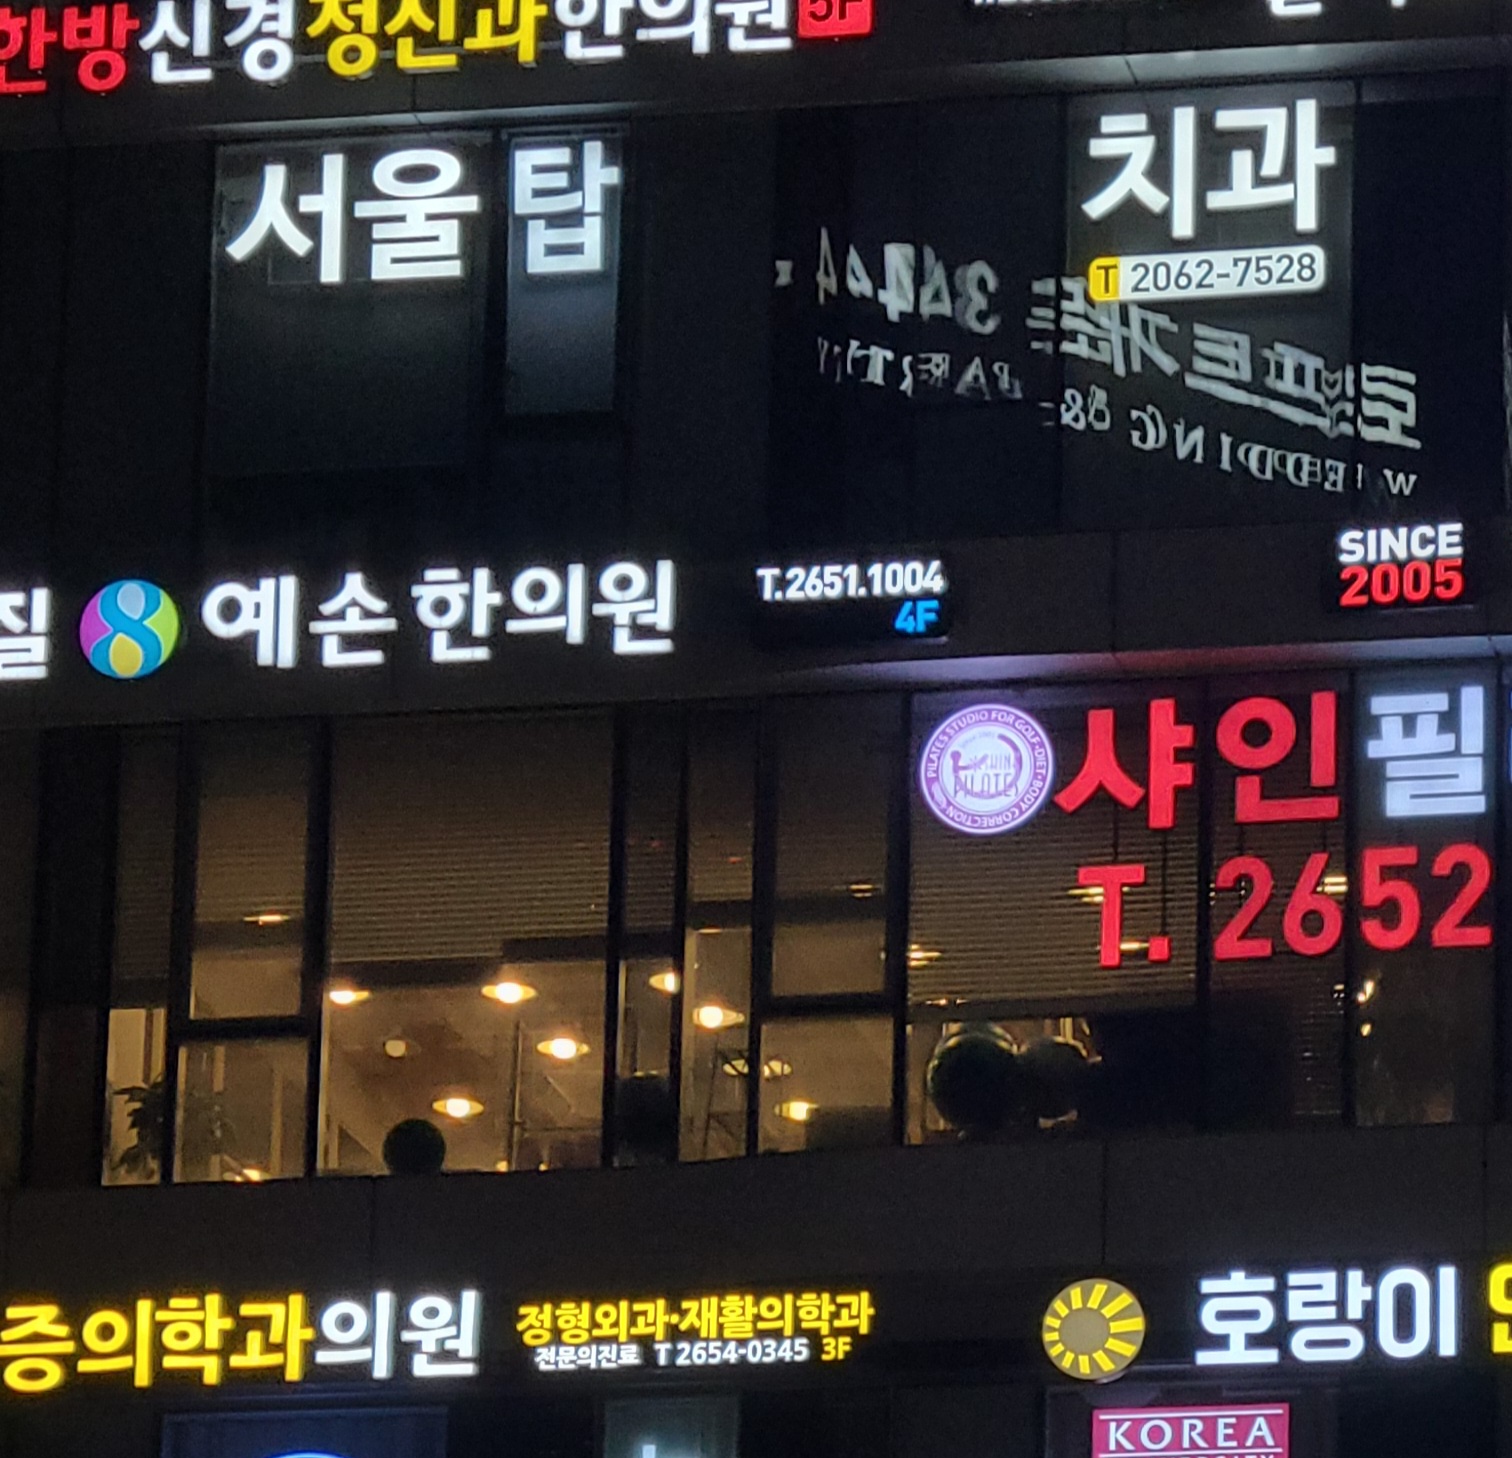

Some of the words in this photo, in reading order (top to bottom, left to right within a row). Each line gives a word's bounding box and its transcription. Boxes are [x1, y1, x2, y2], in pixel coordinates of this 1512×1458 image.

[225, 149, 480, 283] 서울
[514, 141, 620, 275] 탑
[1081, 99, 1336, 239] 치과
[1094, 265, 1118, 296] T
[1129, 253, 1317, 295] 2062-7528
[1338, 523, 1463, 565] SINCE
[757, 559, 944, 602] T.2651.1004
[1338, 560, 1463, 606] 2005
[894, 600, 940, 634] 4F
[945, 710, 989, 735] STUDIO
[990, 710, 1015, 725] FOR
[1195, 1265, 1457, 1366] 호랑이
[533, 1344, 640, 1372] 전문의진료
[654, 1343, 669, 1365] T
[674, 1338, 810, 1367] 2654-0345
[820, 1336, 852, 1361] 3F
[1107, 1414, 1277, 1452] KOREA
